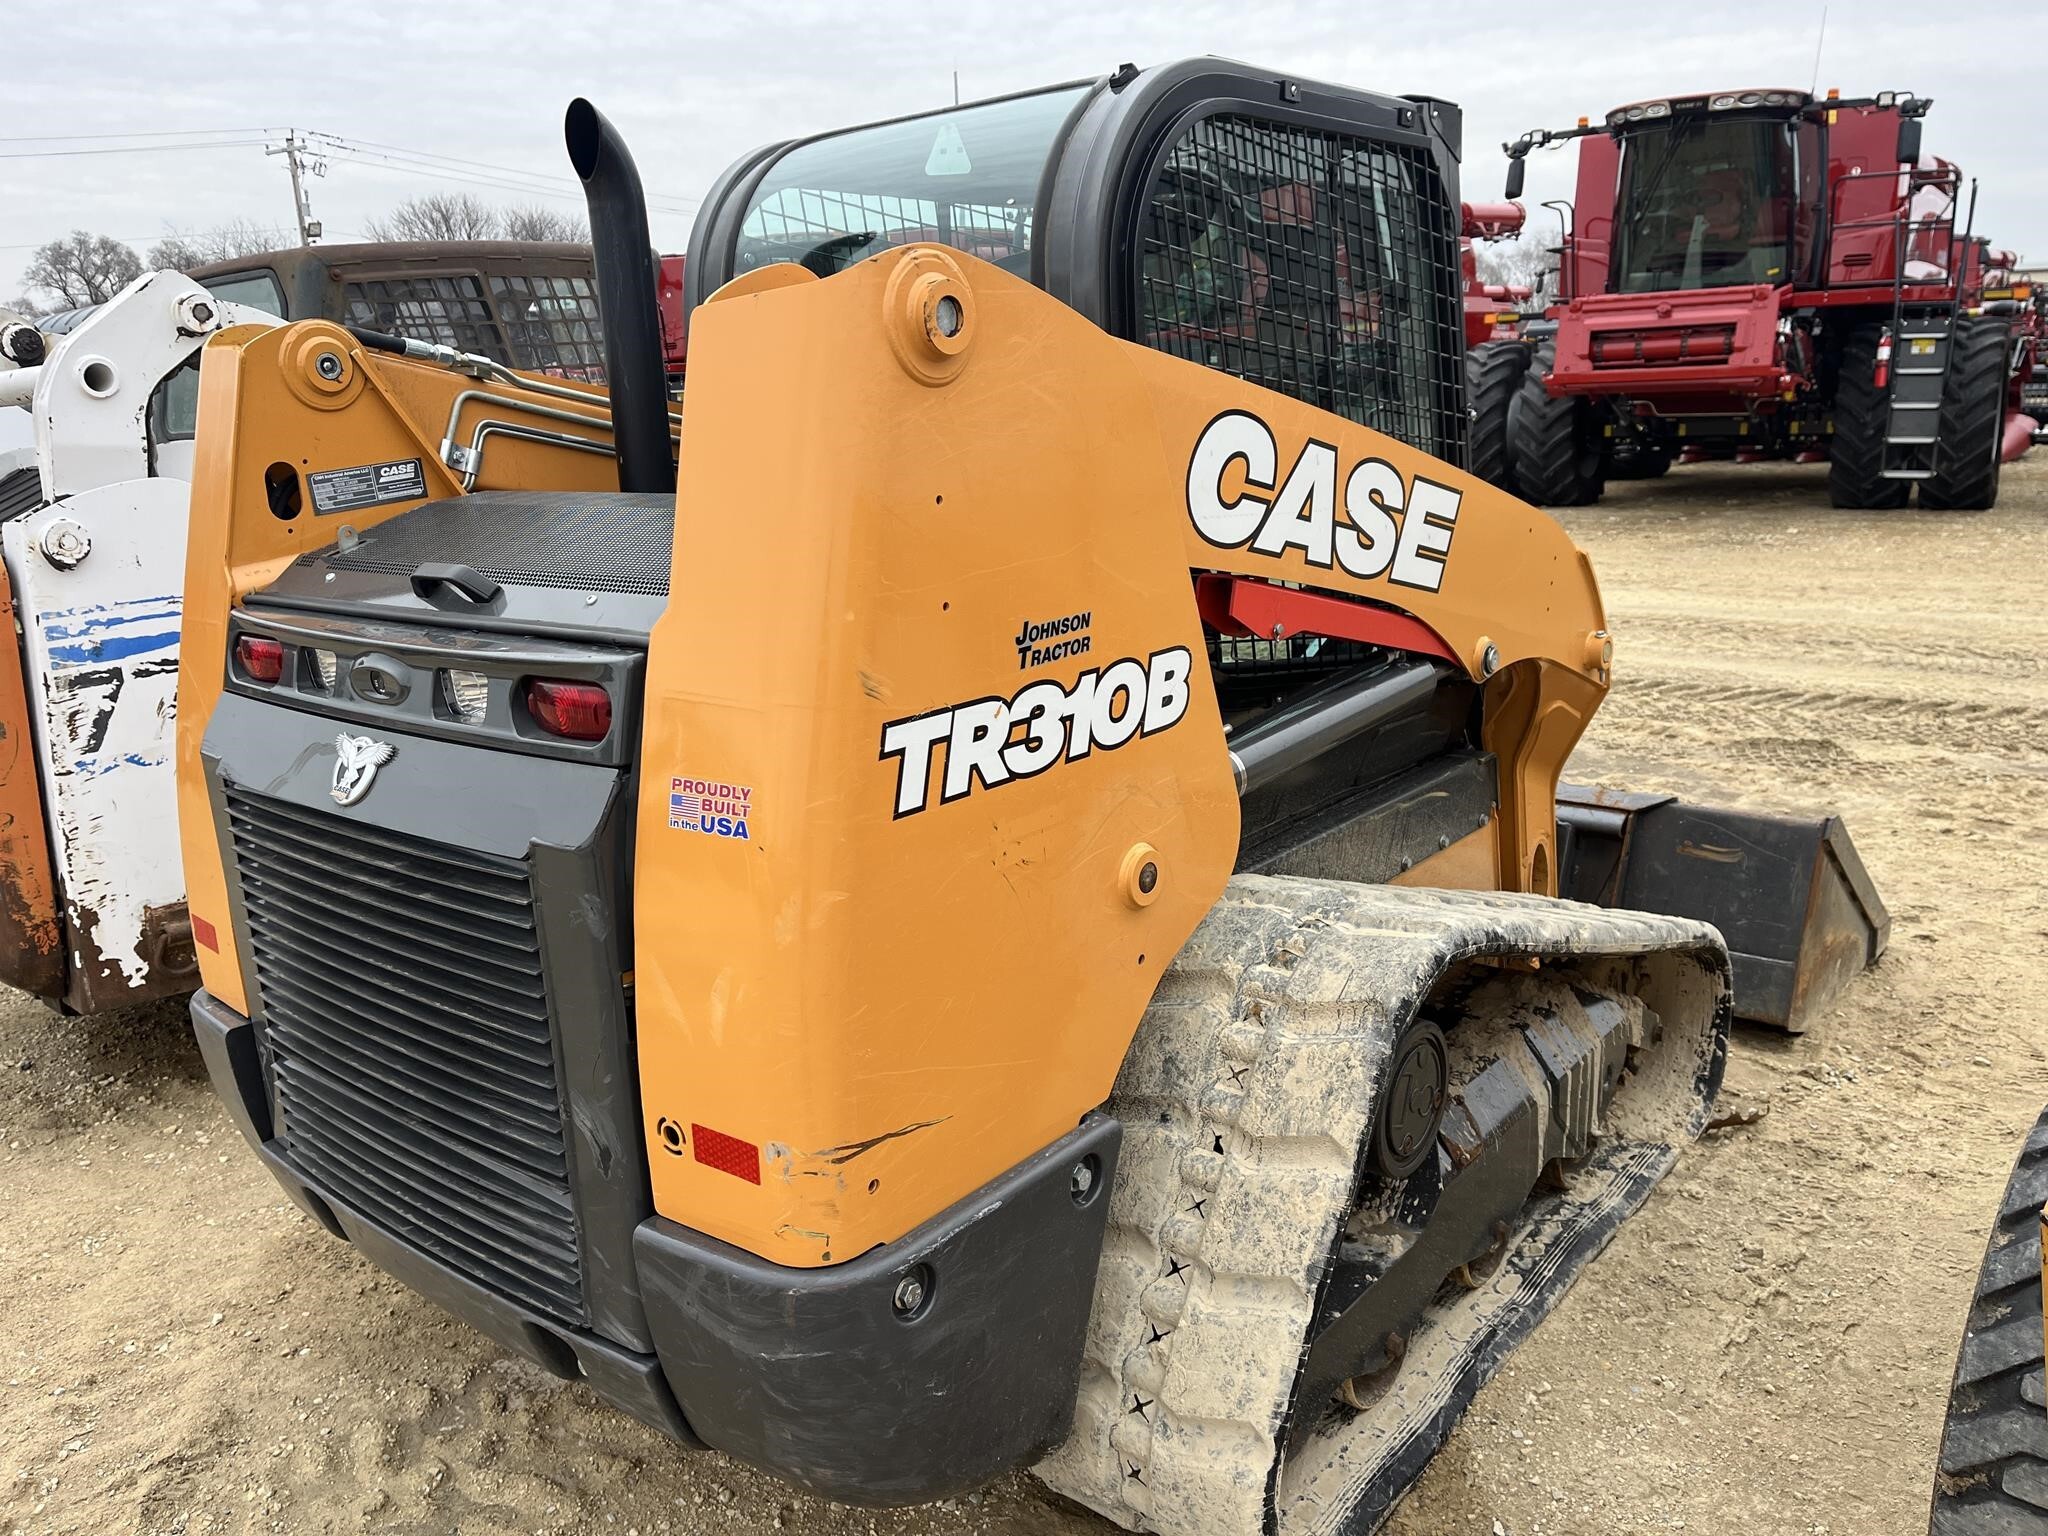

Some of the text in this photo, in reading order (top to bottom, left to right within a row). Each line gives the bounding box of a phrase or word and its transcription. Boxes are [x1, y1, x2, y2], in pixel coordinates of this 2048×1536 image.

[380, 463, 415, 477] CASE
[1185, 409, 1463, 593] CASE
[879, 645, 1192, 821] TR310B
[672, 777, 752, 801] PROUDLY
[701, 798, 751, 818] BUILT
[670, 815, 749, 839] in the USA
